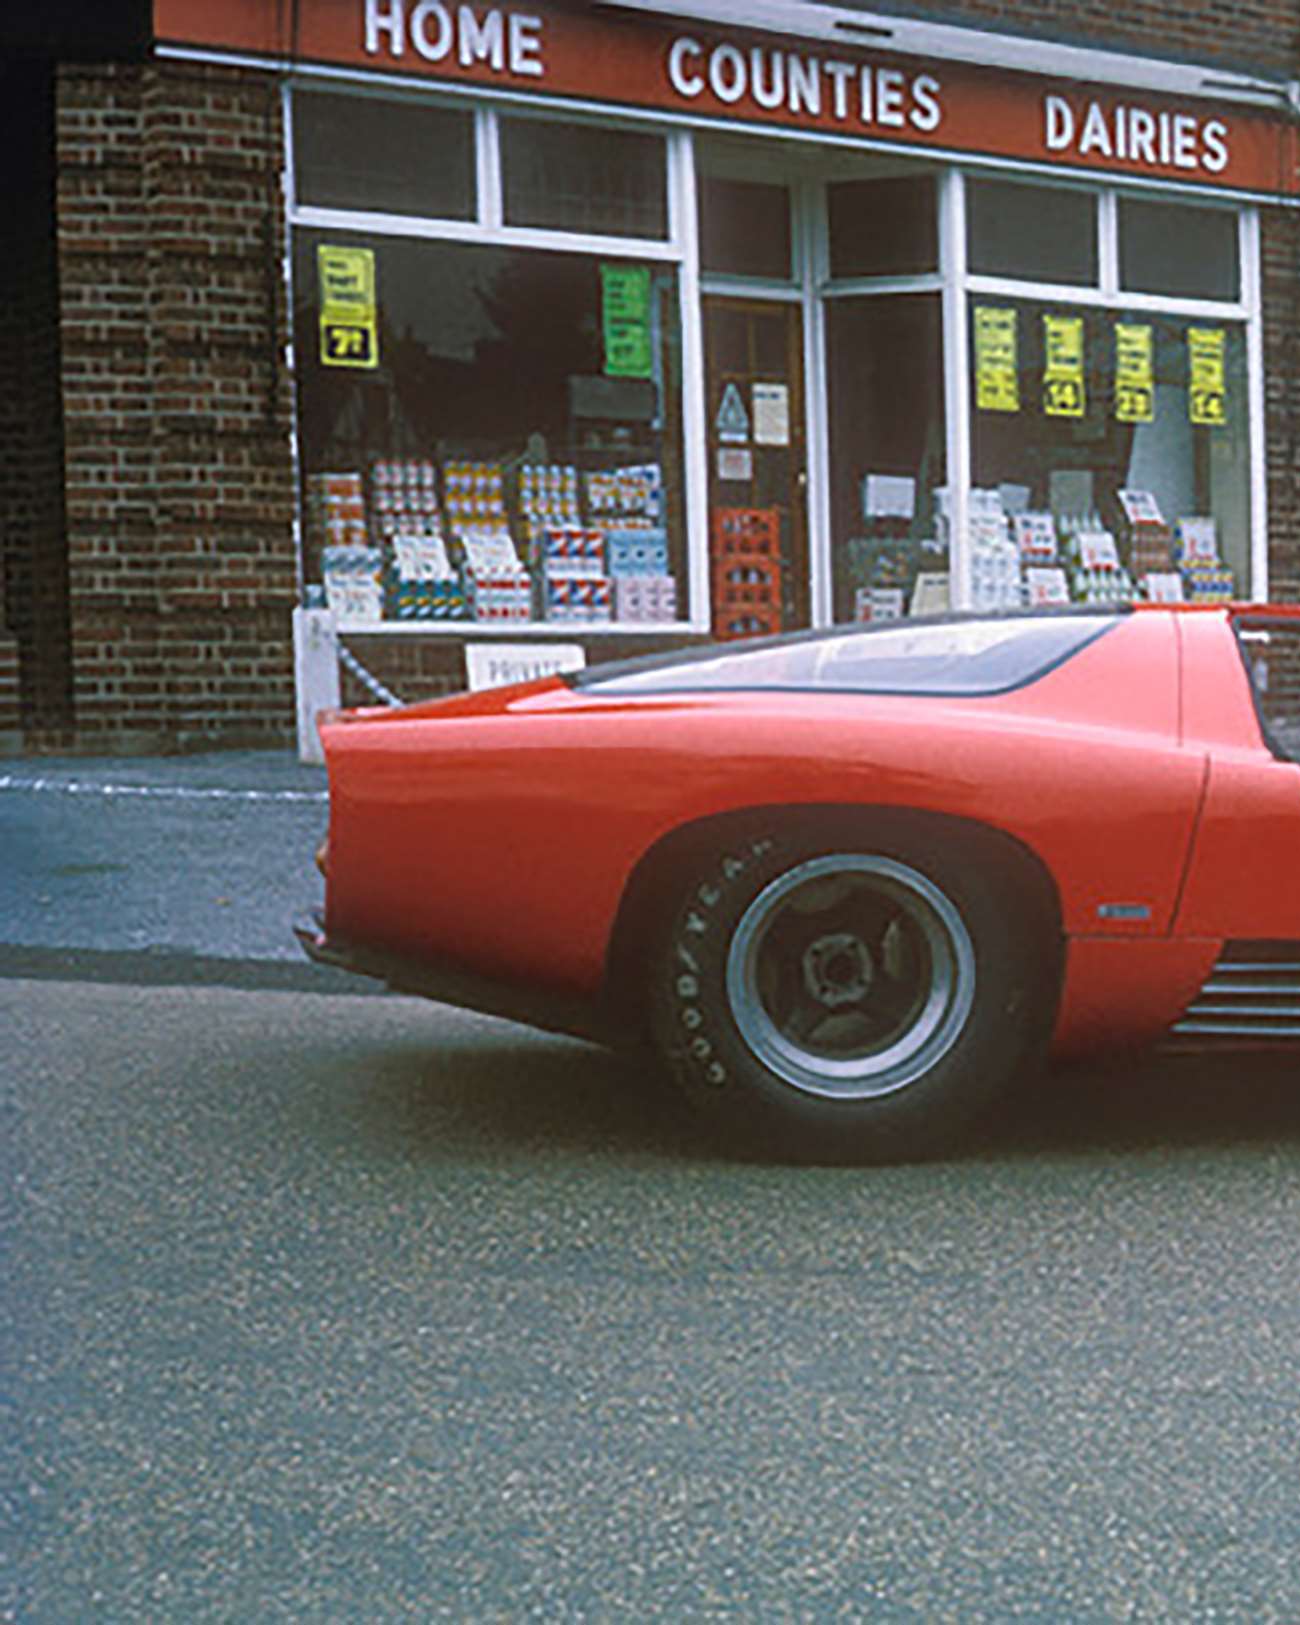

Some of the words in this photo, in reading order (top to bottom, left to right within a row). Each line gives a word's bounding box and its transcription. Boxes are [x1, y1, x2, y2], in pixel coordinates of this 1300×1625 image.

[365, 0, 545, 76] HOME
[668, 37, 941, 132] COUNTIES
[1045, 96, 1228, 171] DAIRIES
